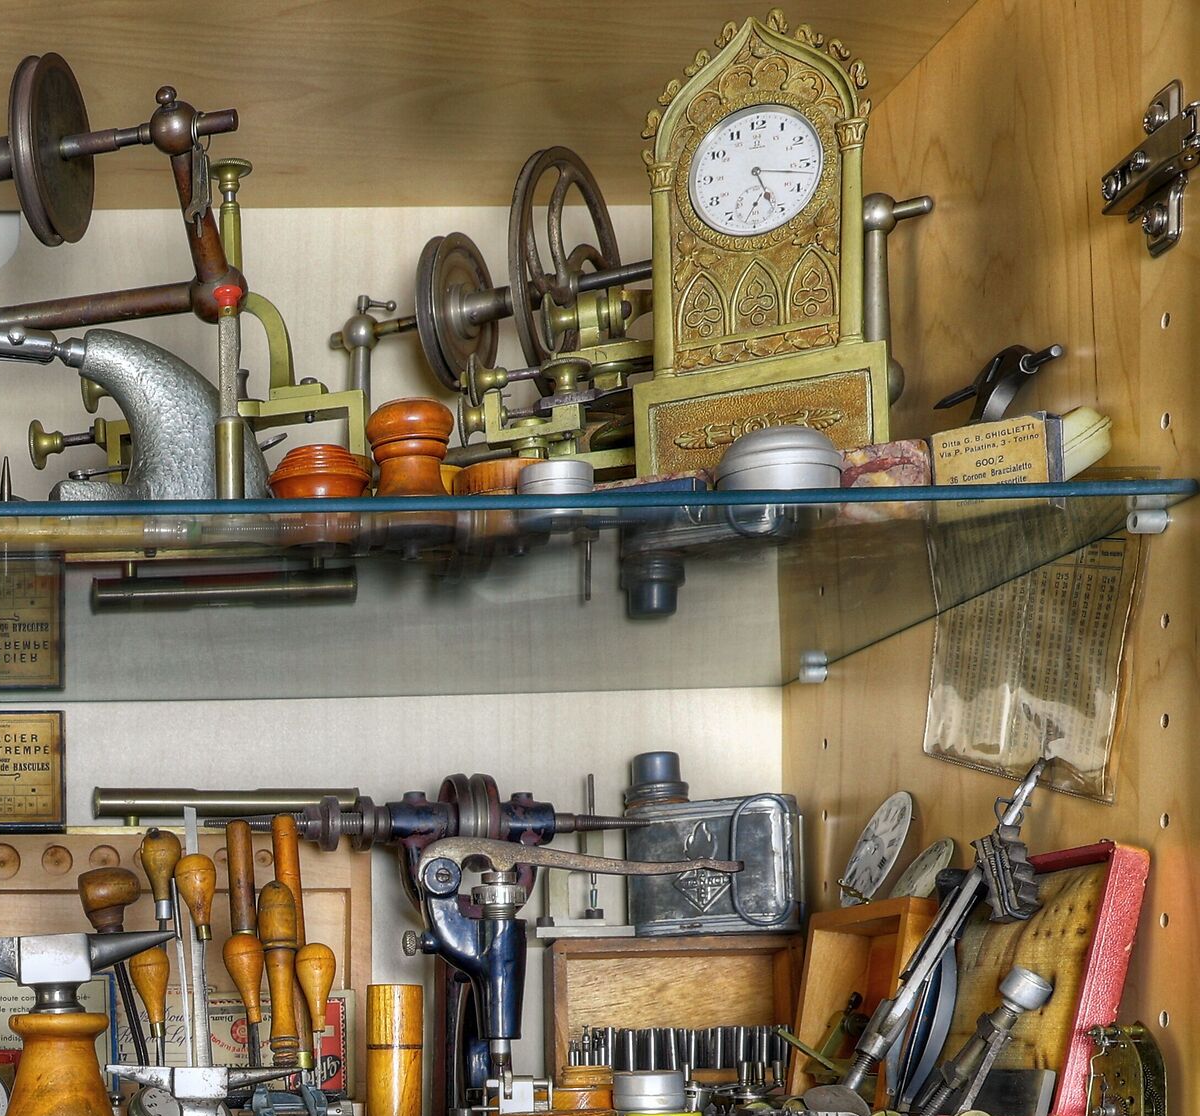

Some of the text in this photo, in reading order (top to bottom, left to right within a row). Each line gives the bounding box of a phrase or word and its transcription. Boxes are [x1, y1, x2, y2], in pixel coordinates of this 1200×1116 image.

[750, 120, 767, 131] 12
[730, 122, 785, 141] 11 1
[710, 135, 804, 160] 10 2
[703, 175, 714, 185] 9
[709, 196, 720, 206] 8
[942, 440, 961, 449] Ditta
[985, 423, 1035, 440] GHIGLIETTI
[940, 451, 952, 459] Via
[965, 443, 999, 454] Palatina,
[1014, 433, 1040, 443] Torino
[963, 472, 987, 482] Corone
[0, 763, 10, 772] de
[13, 762, 51, 772] BASCULES
